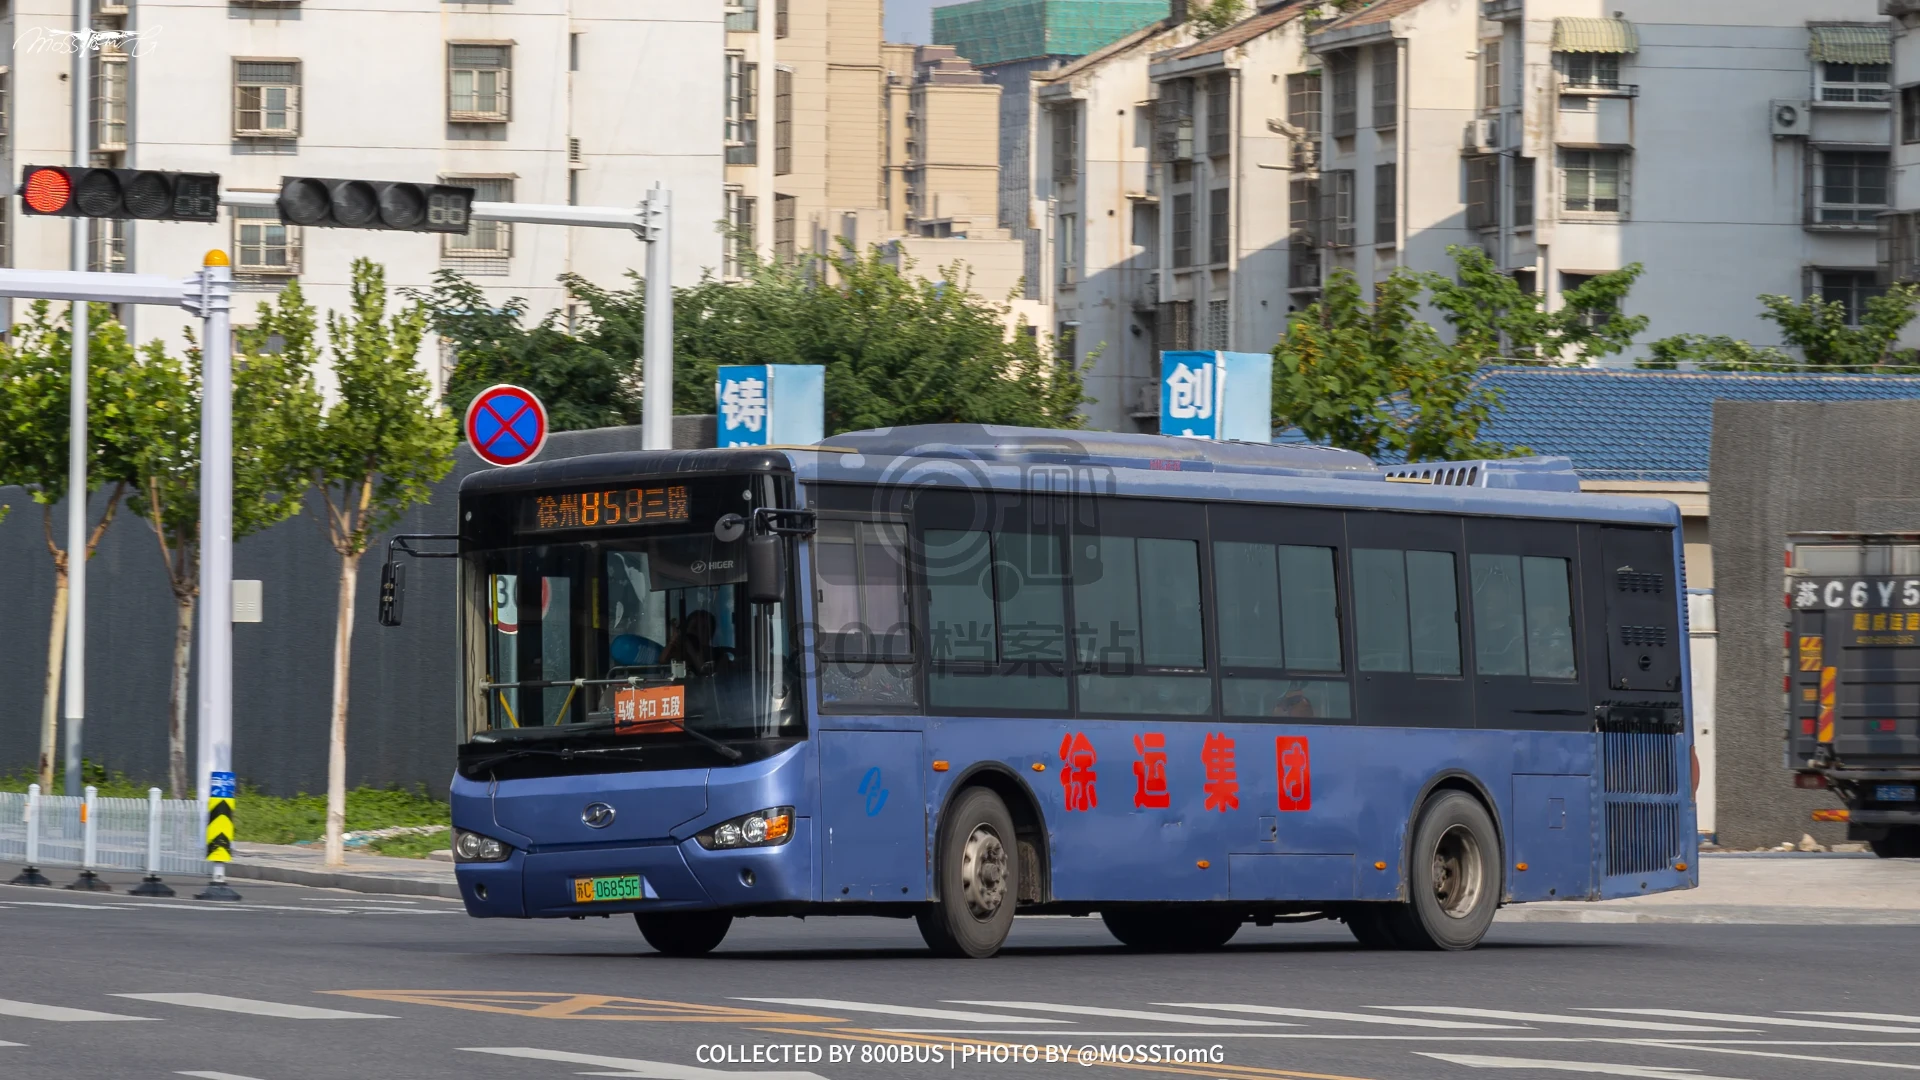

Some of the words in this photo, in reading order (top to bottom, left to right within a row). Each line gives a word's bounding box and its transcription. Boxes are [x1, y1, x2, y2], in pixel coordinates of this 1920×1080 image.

[721, 377, 766, 448] 铸
[1166, 362, 1214, 438] 创
[708, 560, 734, 570] HIGER
[496, 575, 518, 609] 3
[618, 699, 635, 721] 马坡
[639, 698, 656, 718] 许口
[661, 696, 680, 717] 五段
[1059, 731, 1312, 812] 徐运集团
